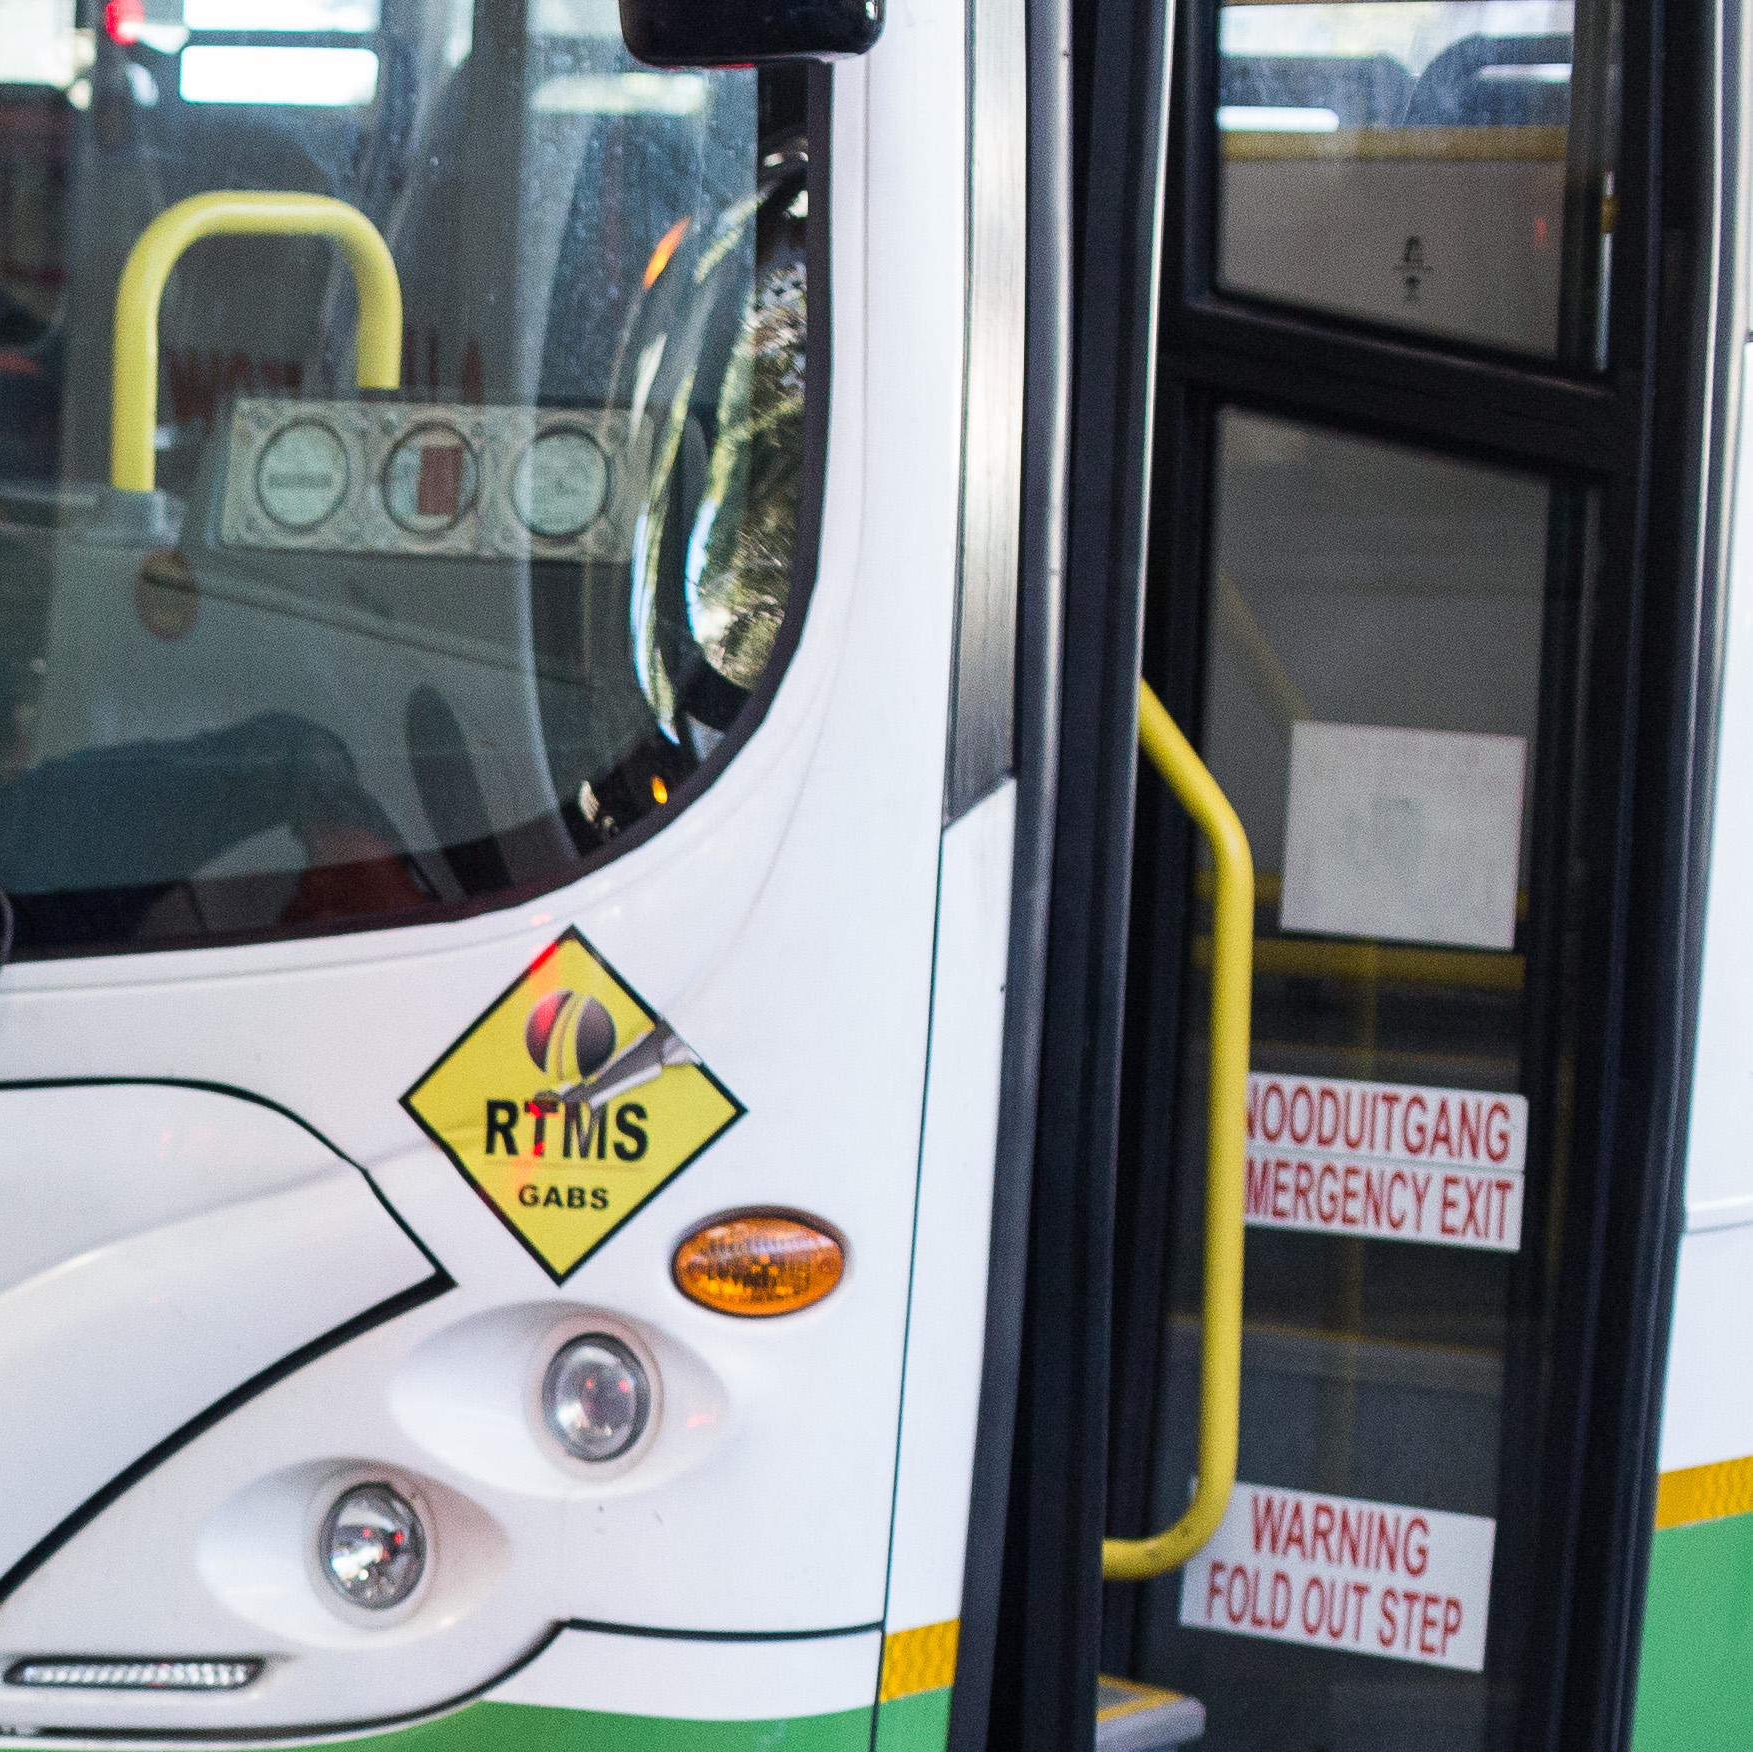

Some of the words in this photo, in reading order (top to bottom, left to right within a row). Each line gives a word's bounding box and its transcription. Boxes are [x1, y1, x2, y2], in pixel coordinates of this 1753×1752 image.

[485, 1098, 649, 1162] RTMS
[518, 1183, 610, 1210] GABS
[1244, 1157, 1431, 1233] MERGENCY
[1440, 1175, 1514, 1241] EXIT
[1251, 1493, 1430, 1577] WARNING
[1204, 1559, 1292, 1630] FOLD
[1301, 1576, 1371, 1640] OUT
[1377, 1587, 1463, 1657] STEP
